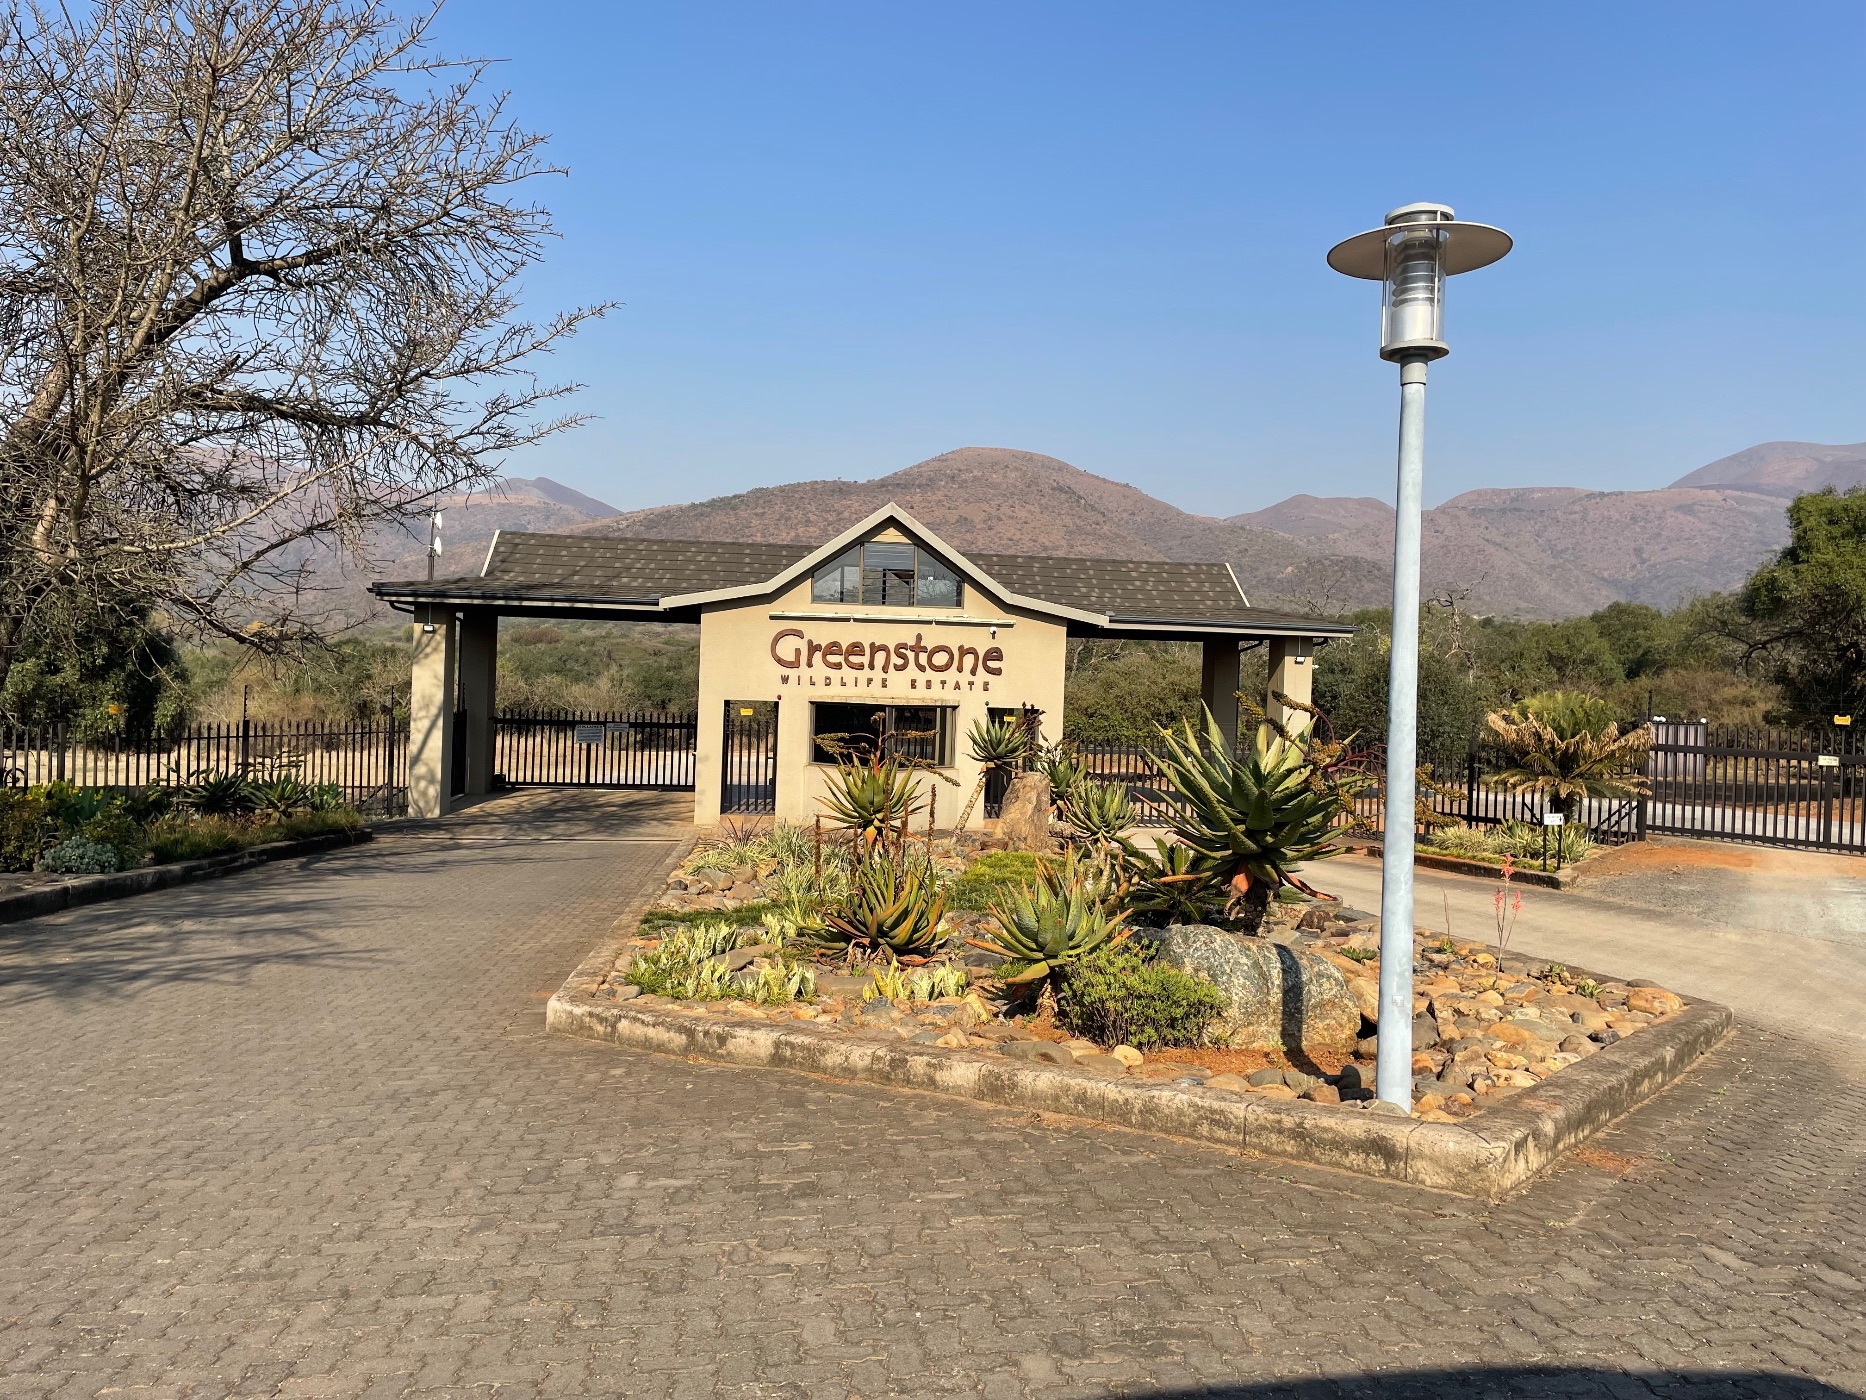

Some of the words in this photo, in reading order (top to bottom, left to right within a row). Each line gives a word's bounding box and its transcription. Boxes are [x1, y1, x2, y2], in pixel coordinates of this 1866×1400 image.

[771, 628, 1003, 676] Greenstone
[781, 674, 888, 689] WILDLIFE
[910, 678, 990, 692] ESTATE
